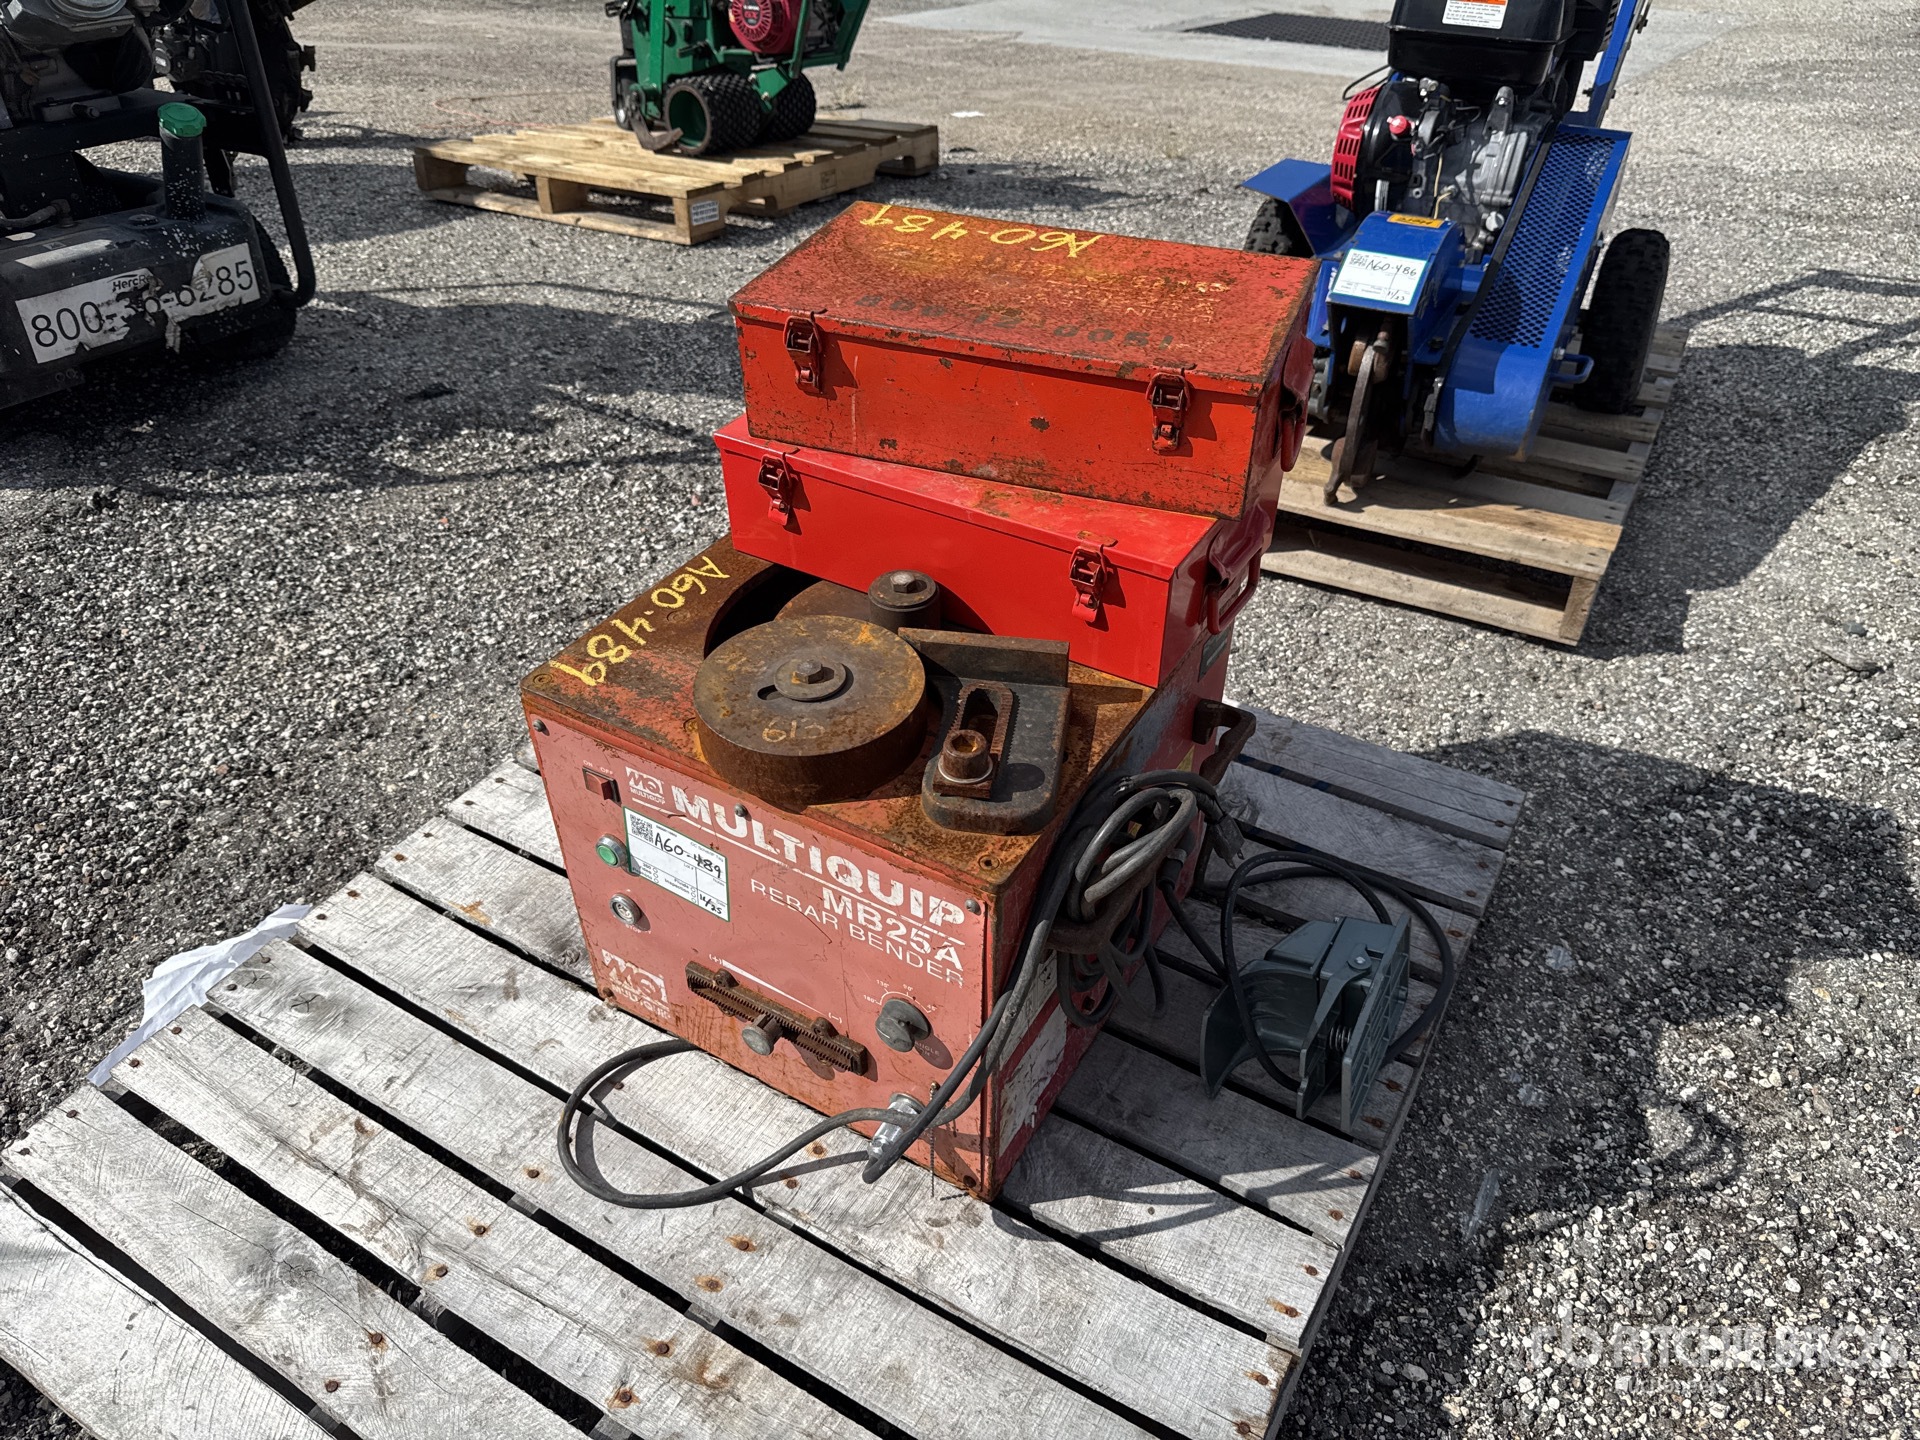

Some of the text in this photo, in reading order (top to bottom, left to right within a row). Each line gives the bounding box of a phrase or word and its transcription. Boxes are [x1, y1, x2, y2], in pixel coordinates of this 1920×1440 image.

[655, 832, 722, 879] A60-489
[671, 784, 966, 927] MULTIQUIP
[750, 878, 964, 989] REBAR BENDER
[822, 886, 964, 972] MB25A
